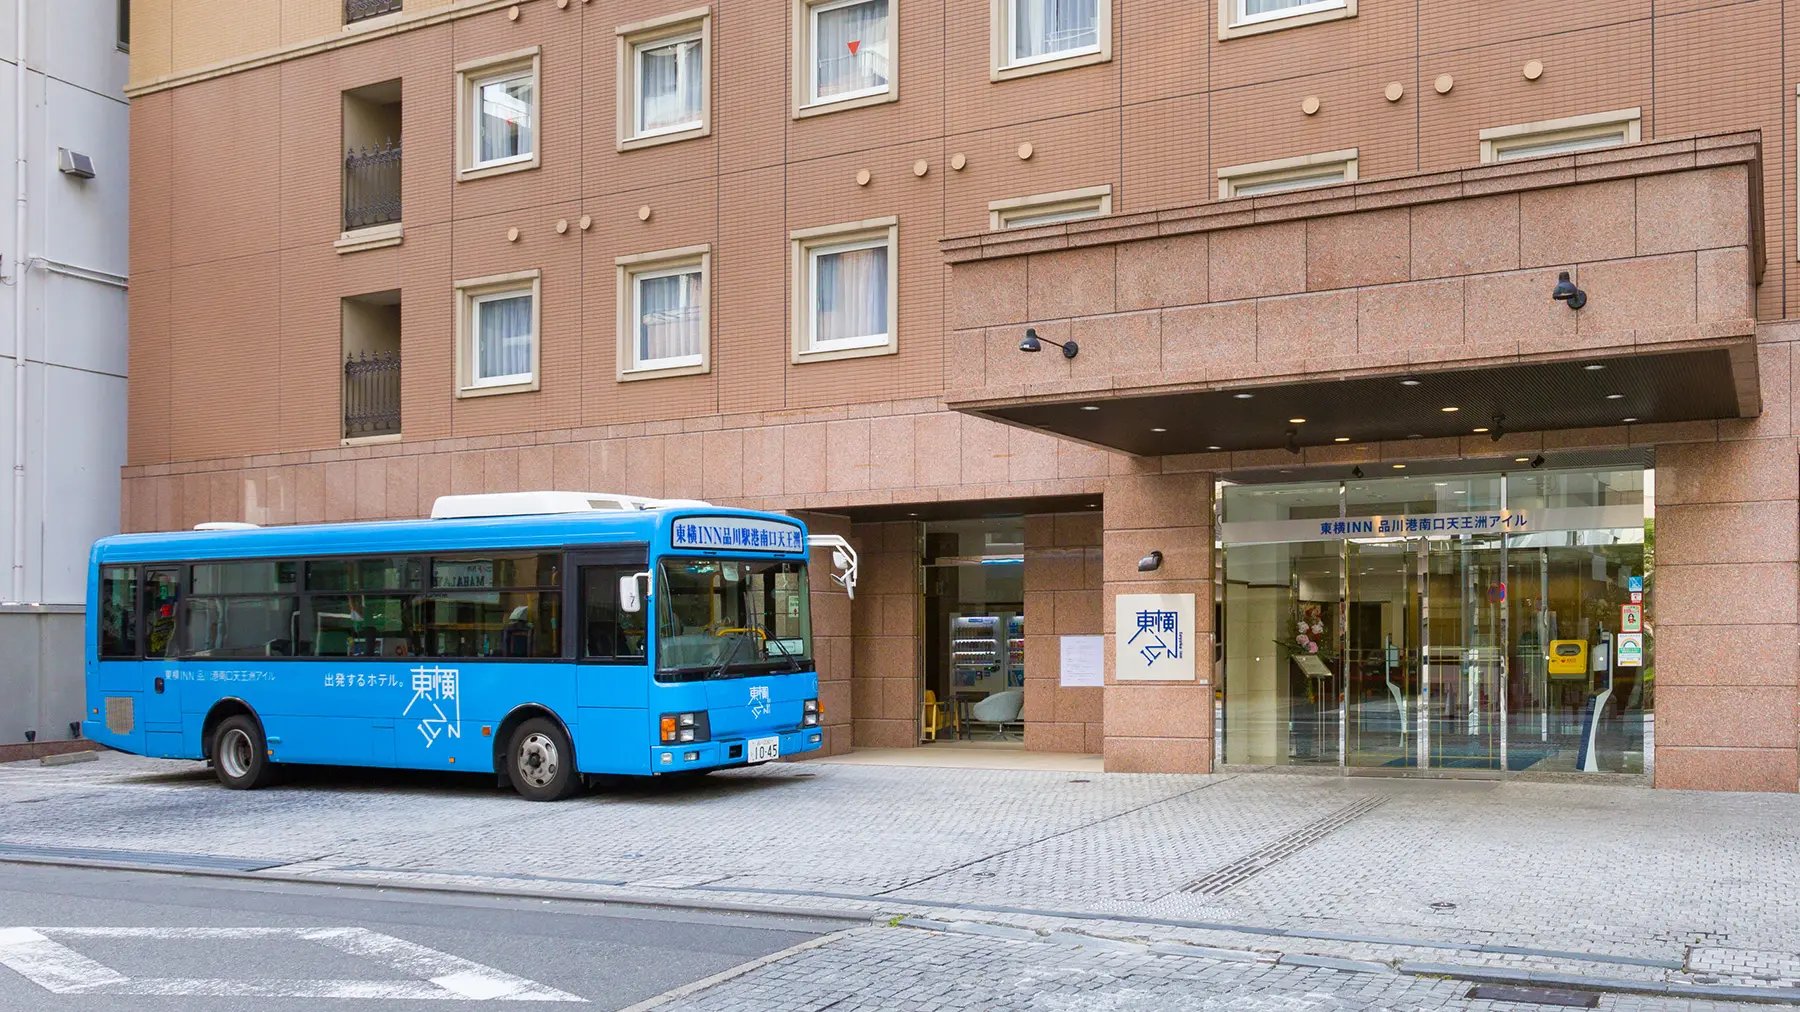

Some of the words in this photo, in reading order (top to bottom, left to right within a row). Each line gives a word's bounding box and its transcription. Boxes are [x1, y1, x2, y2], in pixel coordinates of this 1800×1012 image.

[1320, 521, 1373, 535] 東横INN
[1378, 514, 1528, 533] 品川港南口天王洲アイル
[197, 670, 276, 682] 品港南口天王洲アイル
[324, 672, 404, 688] 出発するホテル。
